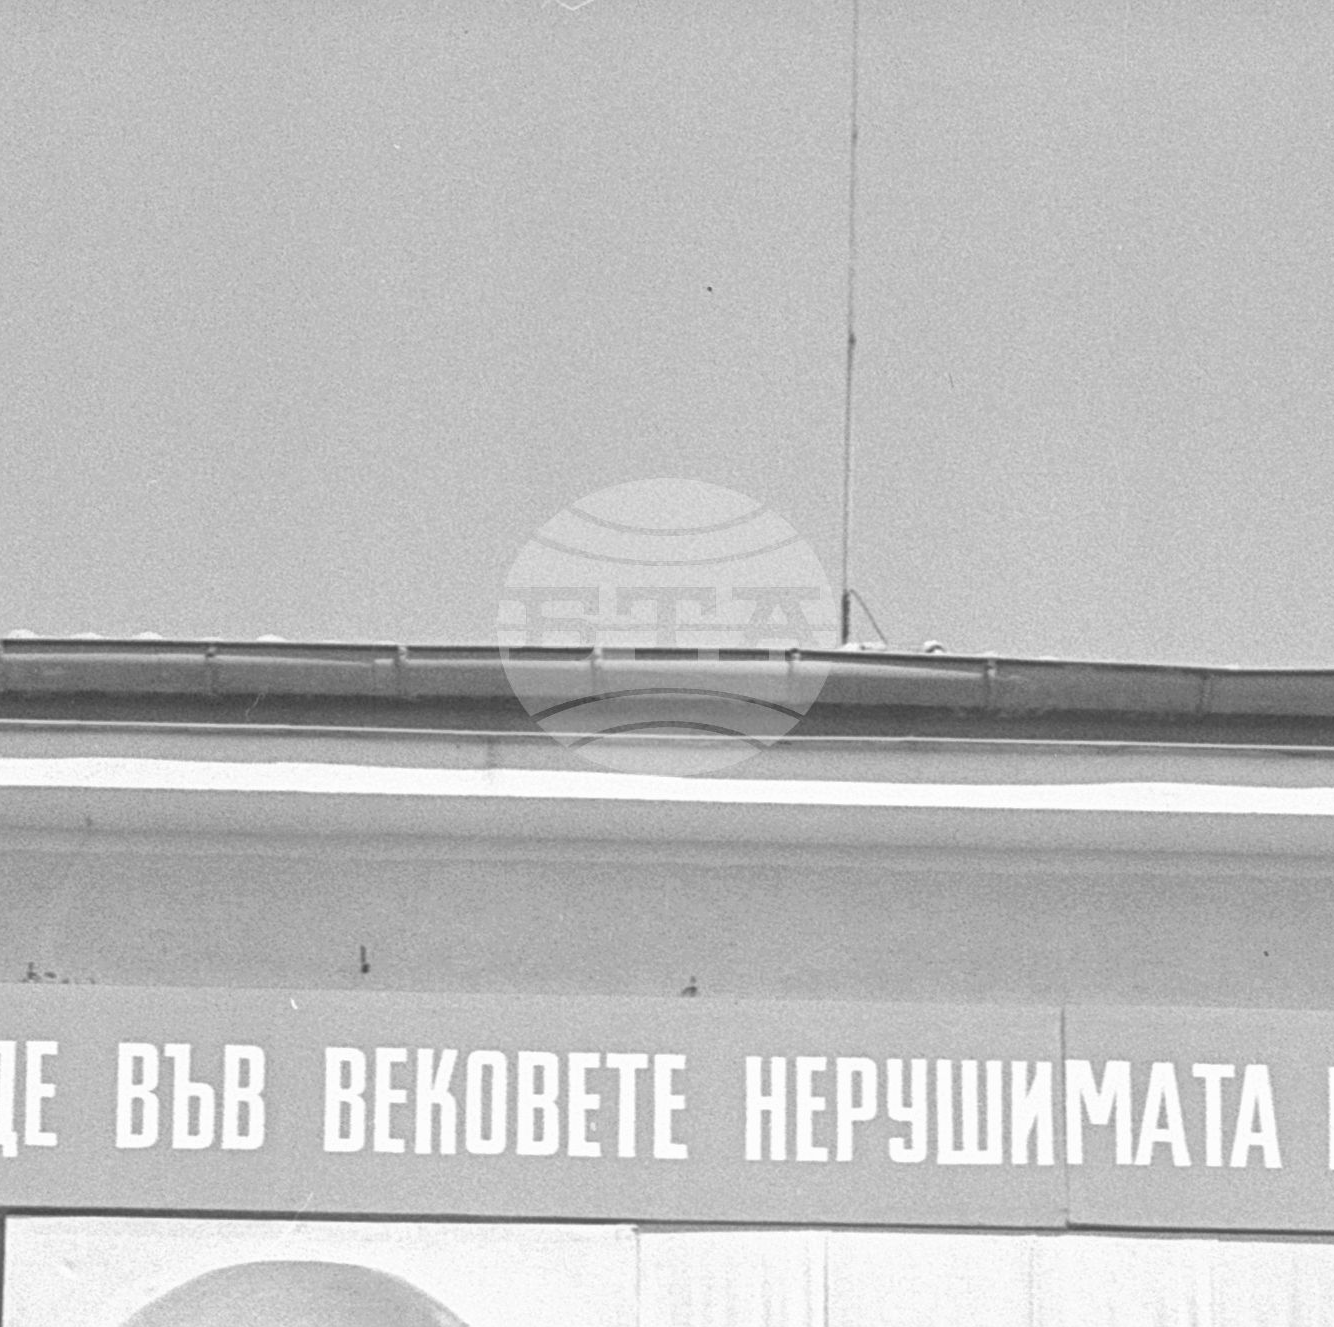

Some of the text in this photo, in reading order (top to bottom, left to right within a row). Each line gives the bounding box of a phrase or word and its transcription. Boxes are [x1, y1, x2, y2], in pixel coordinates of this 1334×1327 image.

[115, 1042, 266, 1151] ВЪВ
[322, 1046, 689, 1160] ВЕКОВЕТЕ
[744, 1055, 1283, 1169] НЕРУШИМАТА
